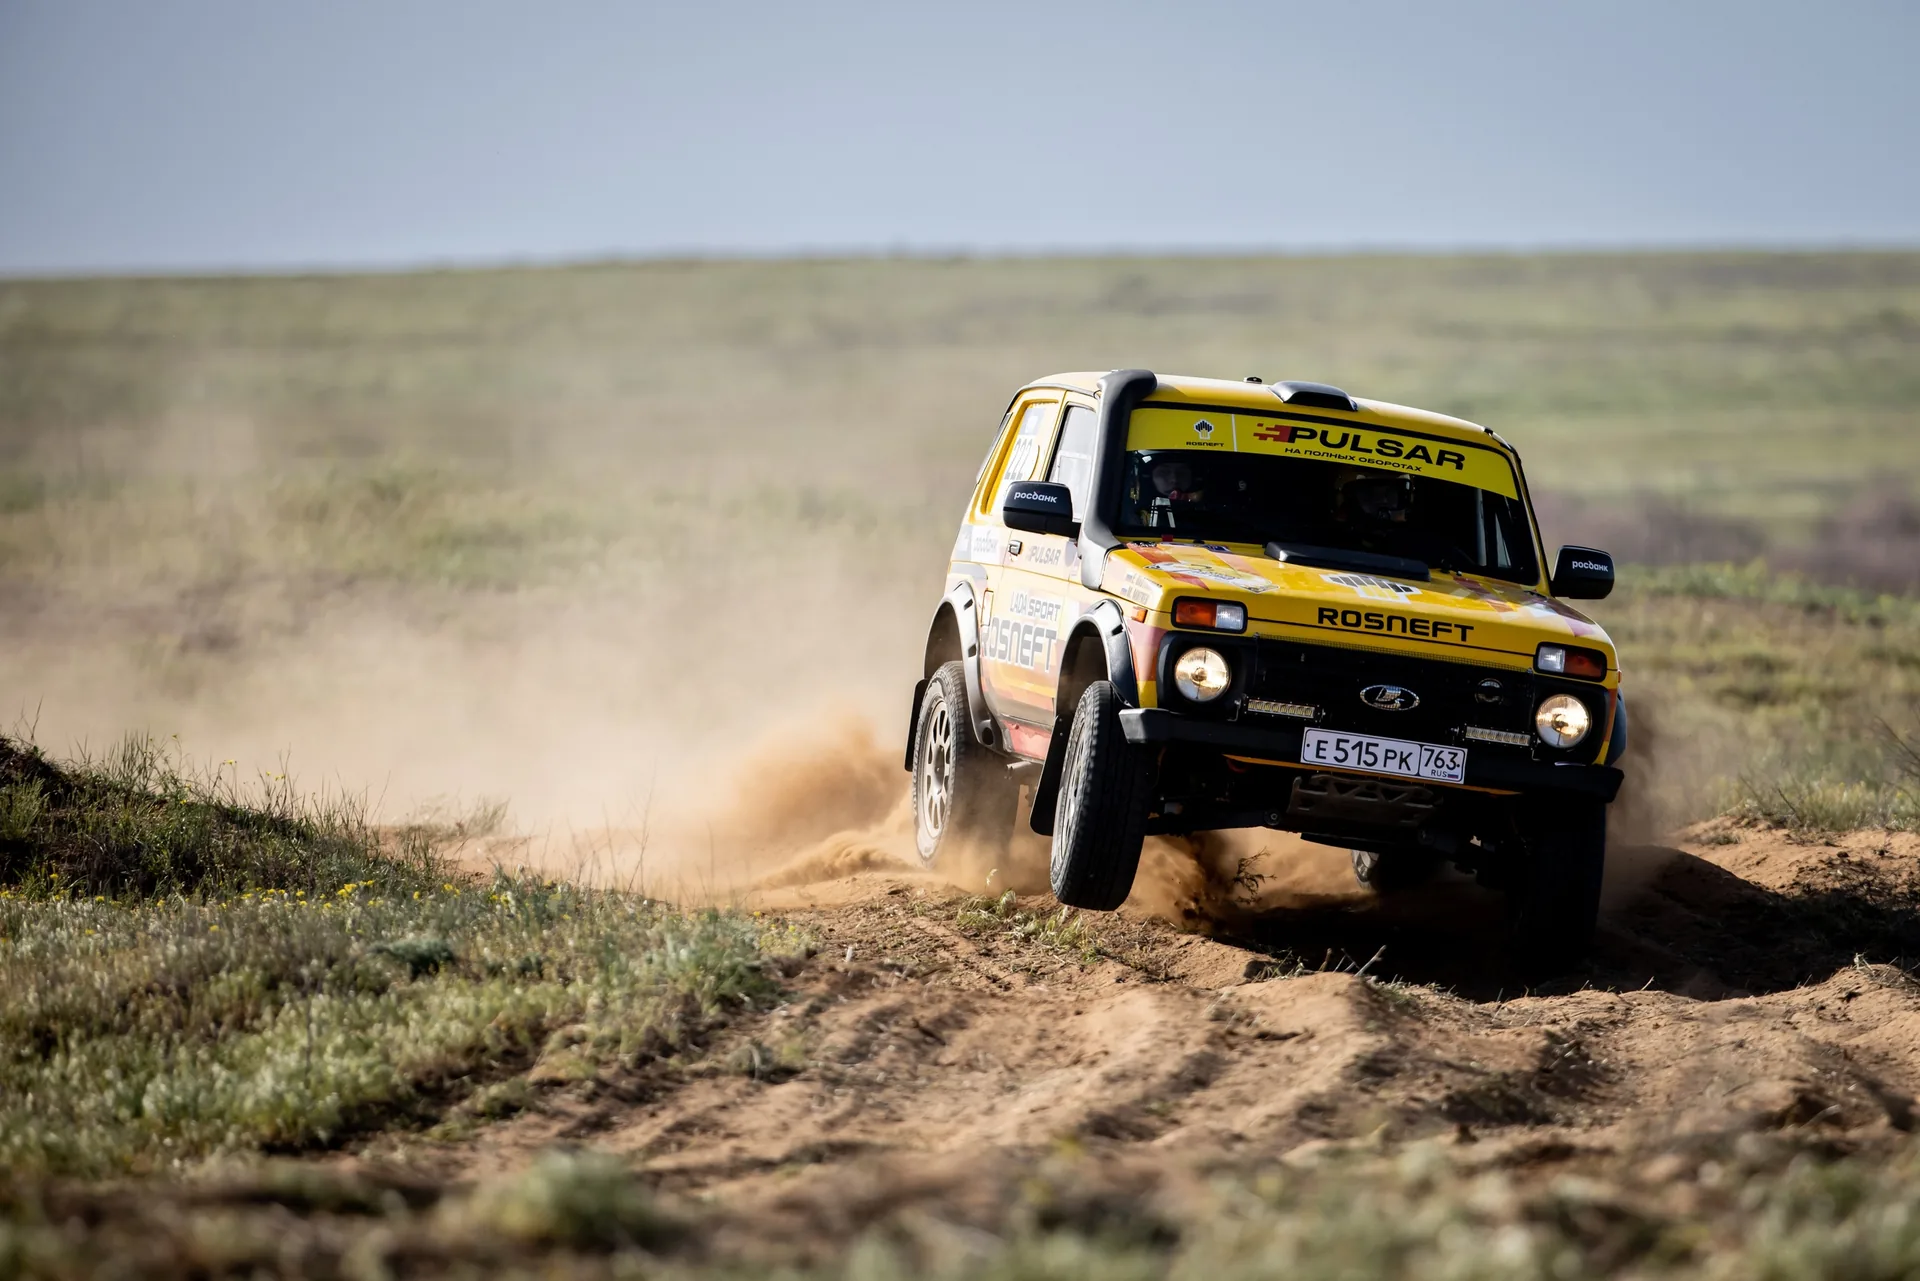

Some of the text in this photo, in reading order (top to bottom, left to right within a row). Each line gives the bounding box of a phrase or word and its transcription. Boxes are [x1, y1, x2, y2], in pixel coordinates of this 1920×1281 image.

[1284, 447, 1422, 472] НА ПОЛНЫХ ОБОРОТАХ
[1288, 426, 1466, 471] PULSAR
[1014, 491, 1057, 503] росбанк
[1030, 545, 1062, 565] PULSAR
[1572, 560, 1608, 571] росбанк
[1028, 597, 1062, 622] SPORT
[1318, 607, 1474, 642] ROSNEFT
[1423, 748, 1458, 770] 763
[1431, 769, 1447, 778] RUS
